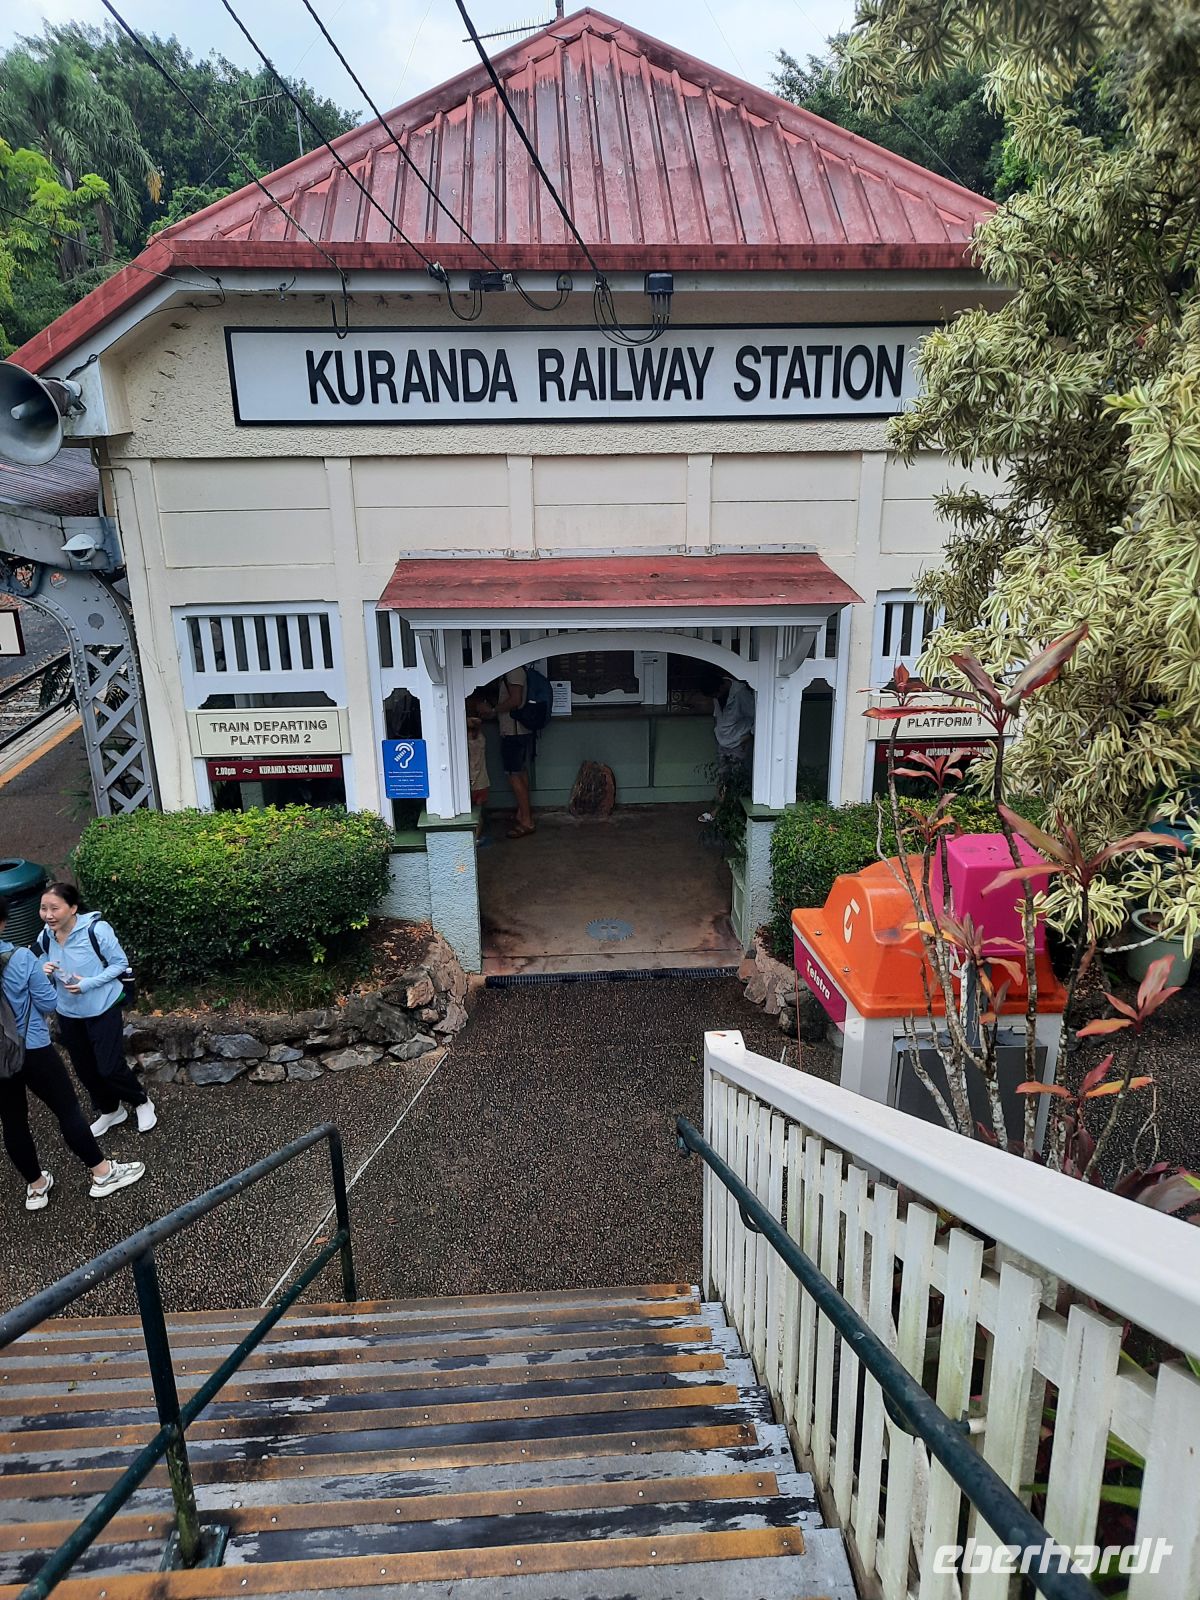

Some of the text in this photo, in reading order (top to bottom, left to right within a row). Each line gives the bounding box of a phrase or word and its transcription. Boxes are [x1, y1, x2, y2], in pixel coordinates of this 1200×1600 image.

[305, 344, 905, 405] KURANDA RAILWAY STATION
[210, 720, 328, 732] TRAIN DEPARTING
[907, 716, 982, 728] PLATFORM 1
[230, 733, 312, 745] PLATFORM 2
[259, 765, 286, 775] KURANDA
[287, 764, 308, 774] SCENIC
[308, 764, 334, 773] RAILWAY
[806, 959, 831, 1000] Telstra
